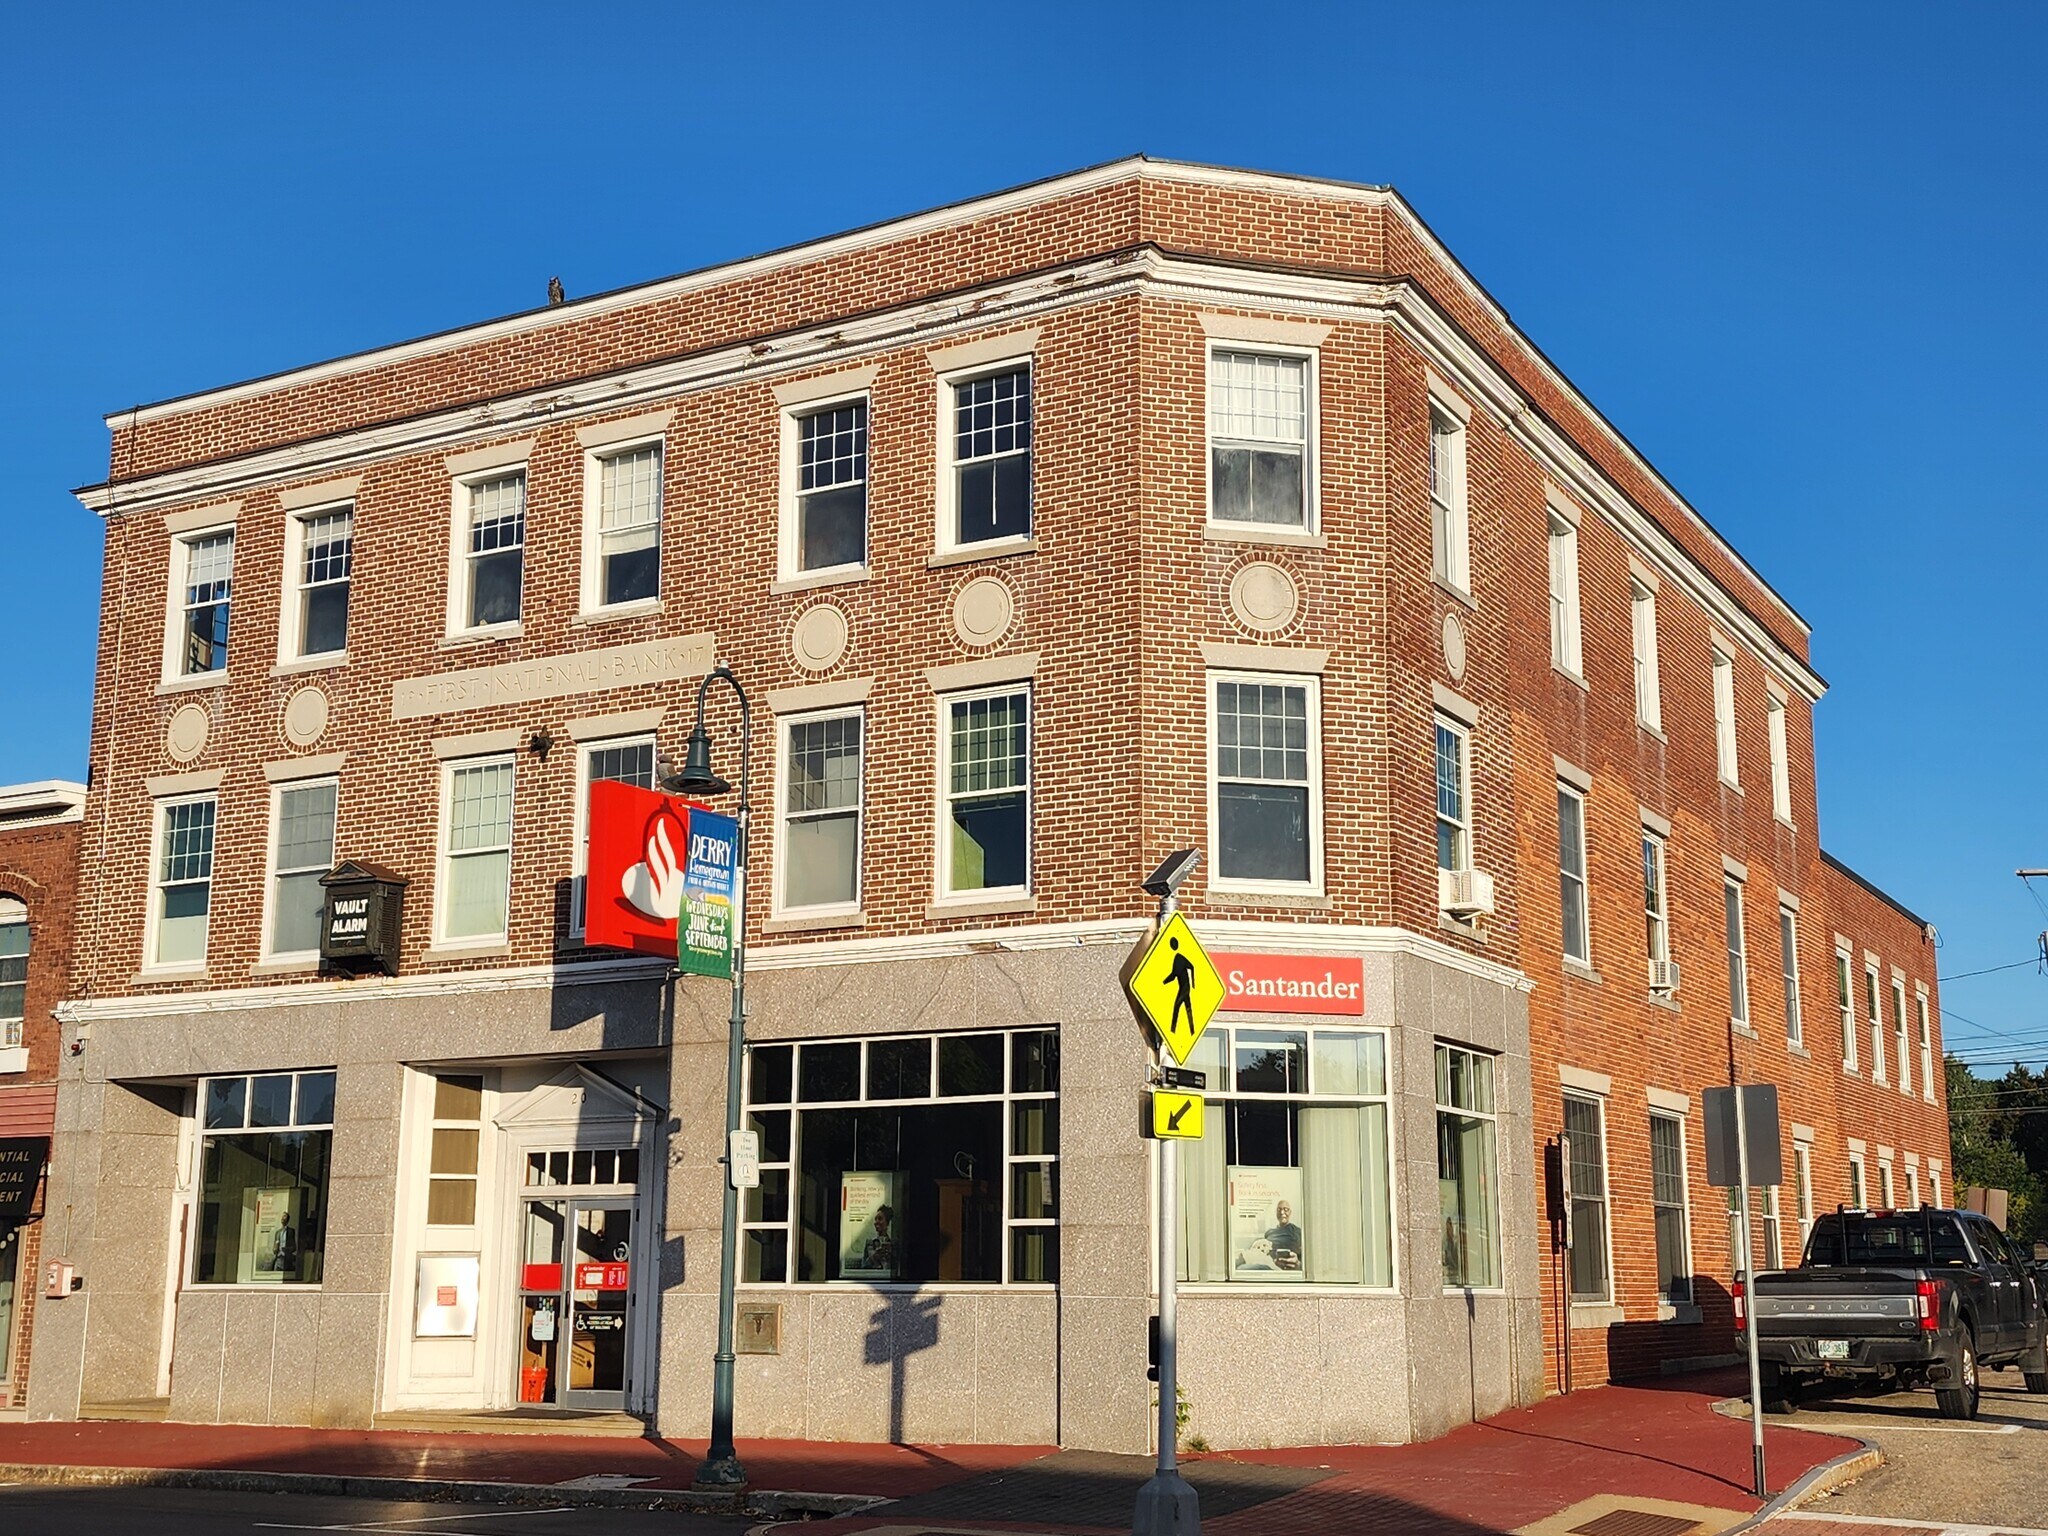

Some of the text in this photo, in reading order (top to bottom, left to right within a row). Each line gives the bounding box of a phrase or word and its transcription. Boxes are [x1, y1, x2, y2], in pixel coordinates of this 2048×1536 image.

[427, 678, 479, 705] FIRST
[495, 661, 598, 695] NATIONAL
[614, 647, 677, 677] BANK
[688, 646, 704, 664] 17
[691, 834, 732, 867] DERRY
[689, 859, 730, 880] Homegrown
[334, 898, 369, 915] VAULT
[686, 900, 728, 920] WEDNESDAYS
[331, 917, 368, 934] ALARM
[688, 914, 710, 933] JUNE
[685, 930, 727, 950] SEPTEMBER
[1229, 970, 1360, 999] Santander
[571, 1092, 587, 1105] 20
[736, 1153, 756, 1161] Parking
